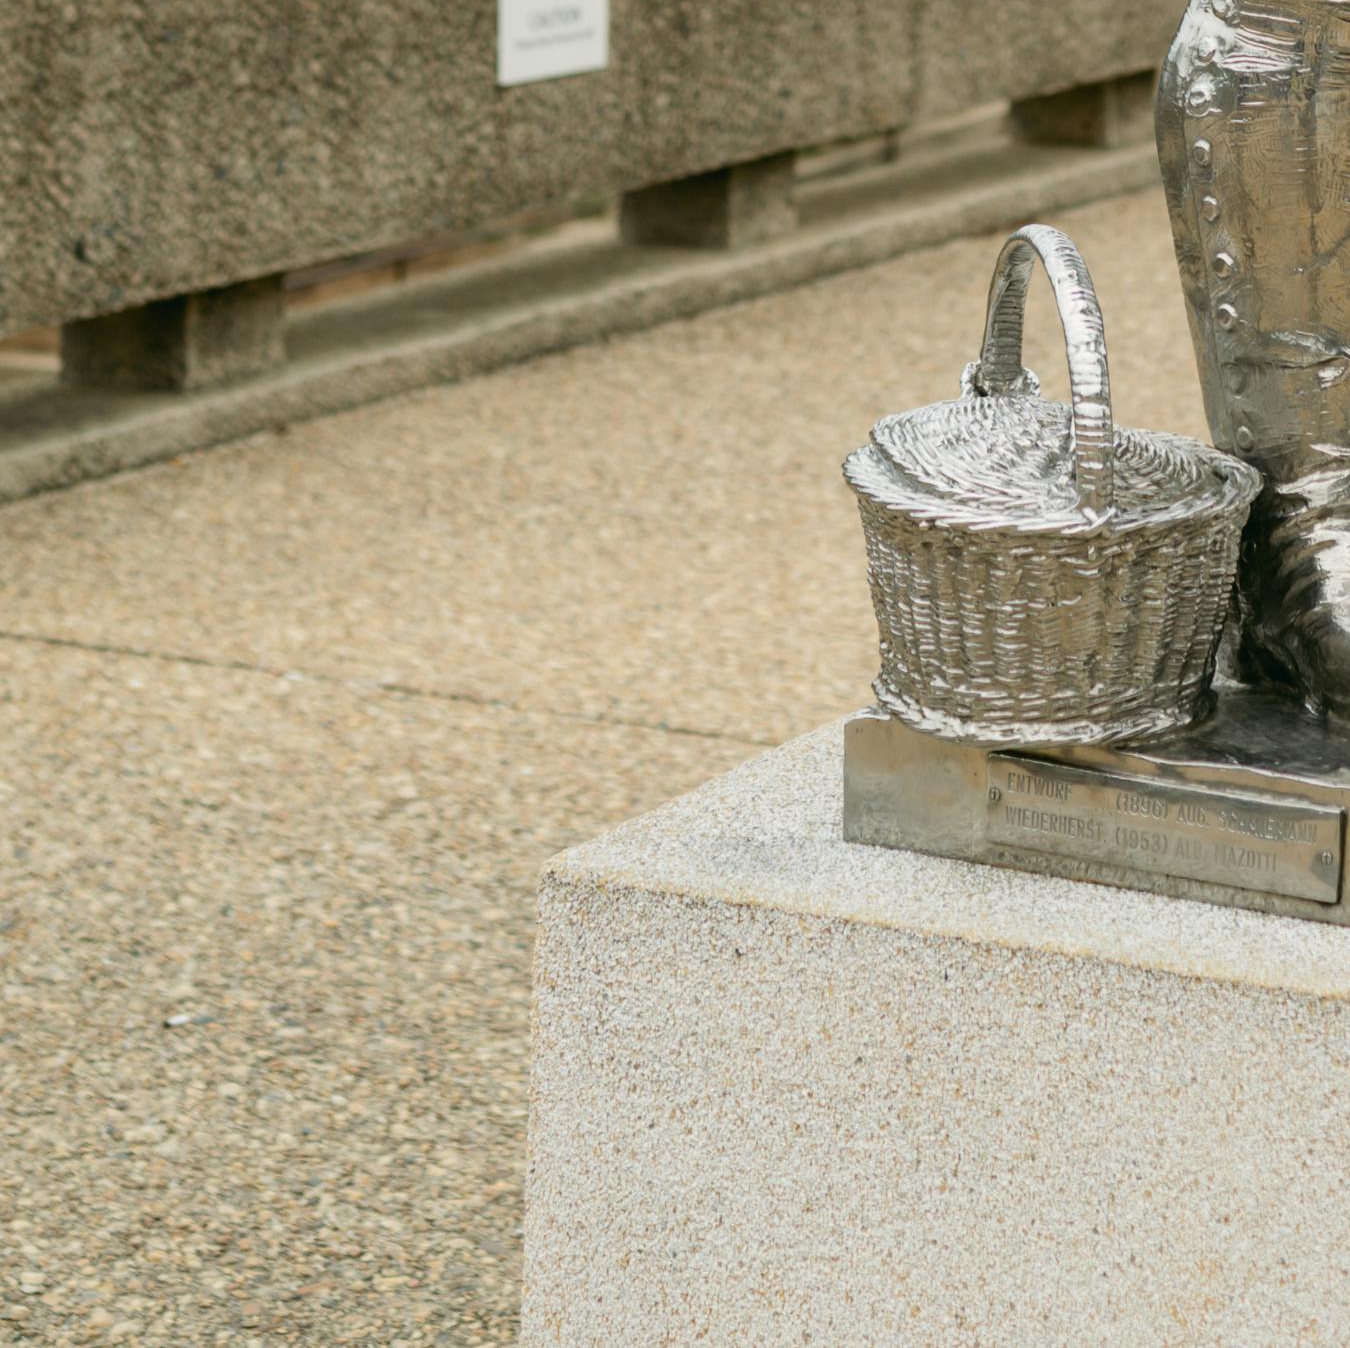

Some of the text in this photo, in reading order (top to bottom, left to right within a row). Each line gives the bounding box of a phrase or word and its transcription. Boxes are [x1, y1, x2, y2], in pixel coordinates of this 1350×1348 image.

[1008, 772, 1073, 802] ENTWURF
[1115, 792, 1168, 822] (1896)
[1176, 804, 1211, 829] AUG.
[1005, 805, 1107, 844] WIEDERHERST.
[1115, 826, 1168, 855] (1953)
